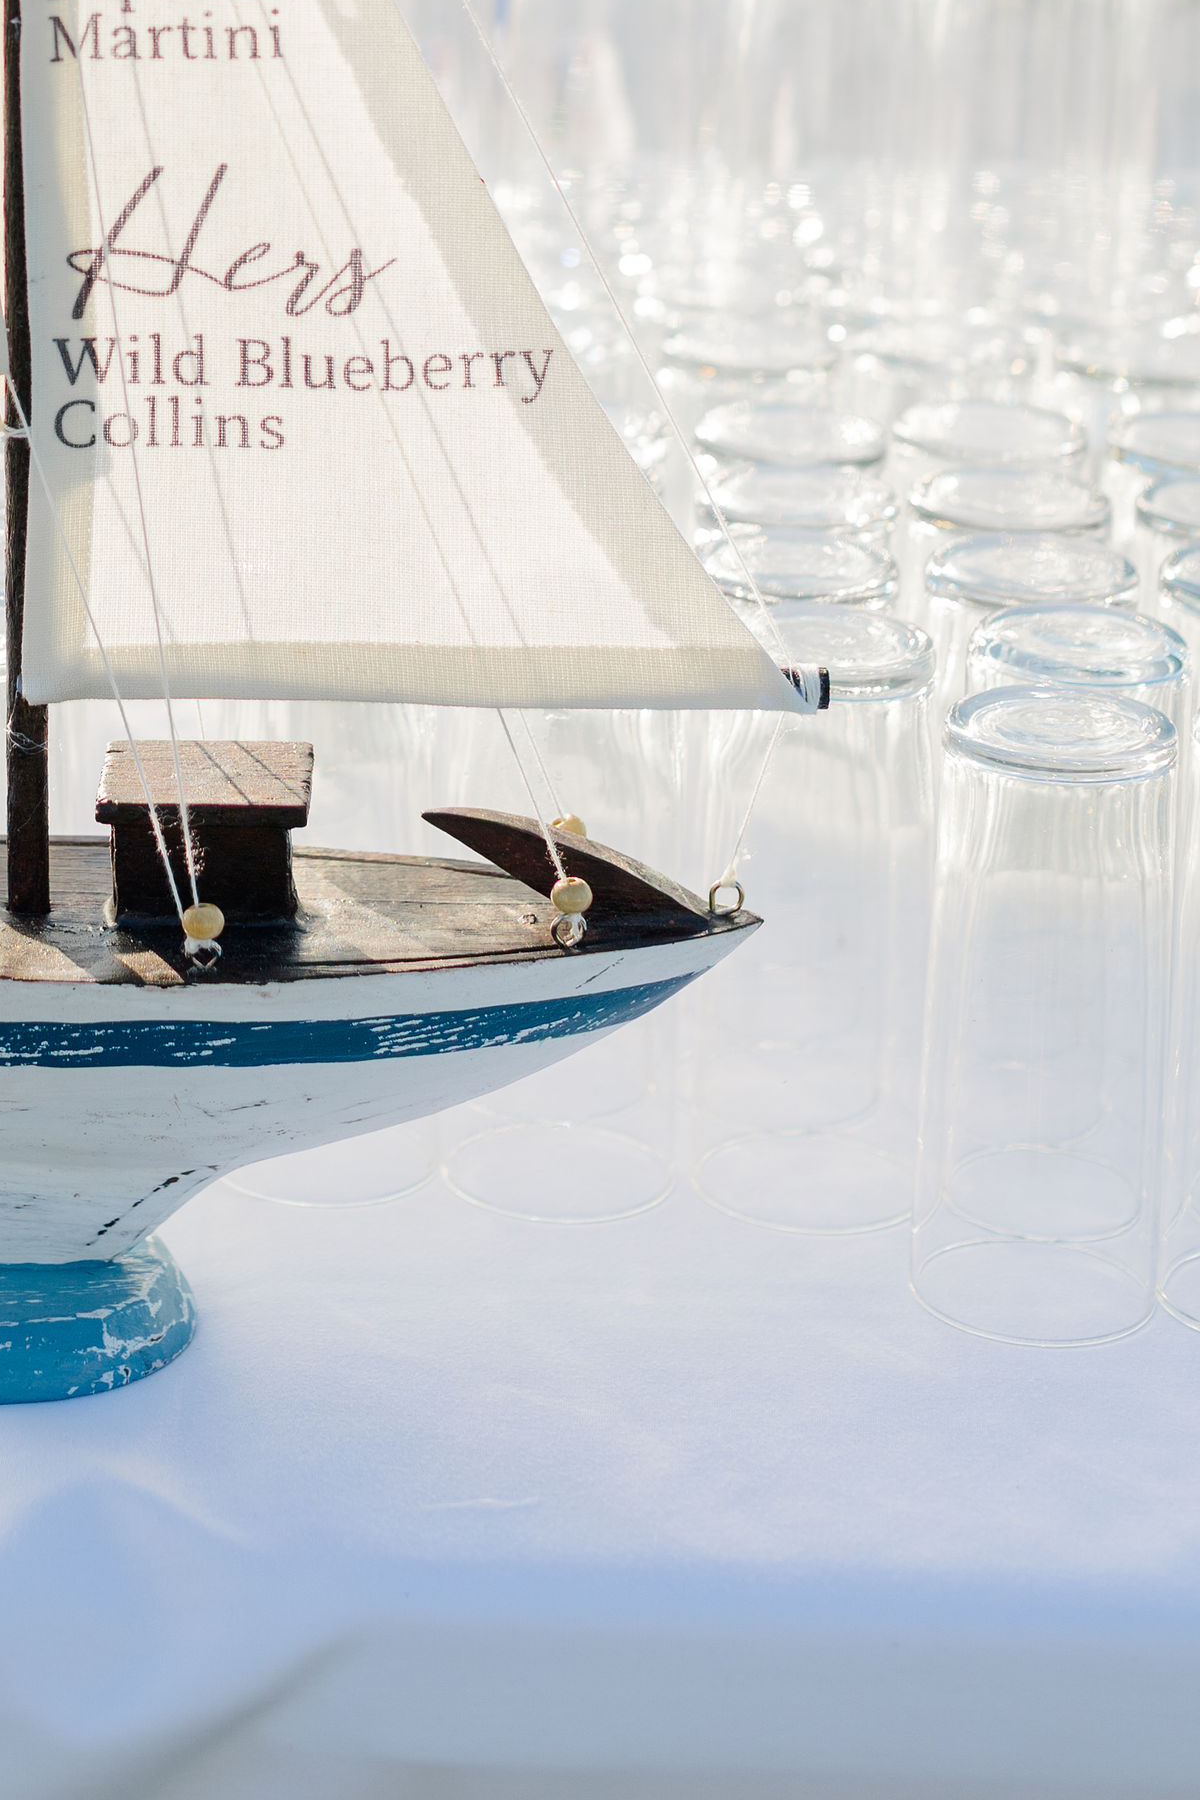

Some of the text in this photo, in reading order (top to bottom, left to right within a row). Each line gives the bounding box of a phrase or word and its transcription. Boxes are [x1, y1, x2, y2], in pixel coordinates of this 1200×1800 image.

[48, 9, 284, 62] Martini
[66, 163, 397, 319] Hers
[52, 333, 553, 403] Wild Blueberry
[53, 396, 285, 449] Collins
